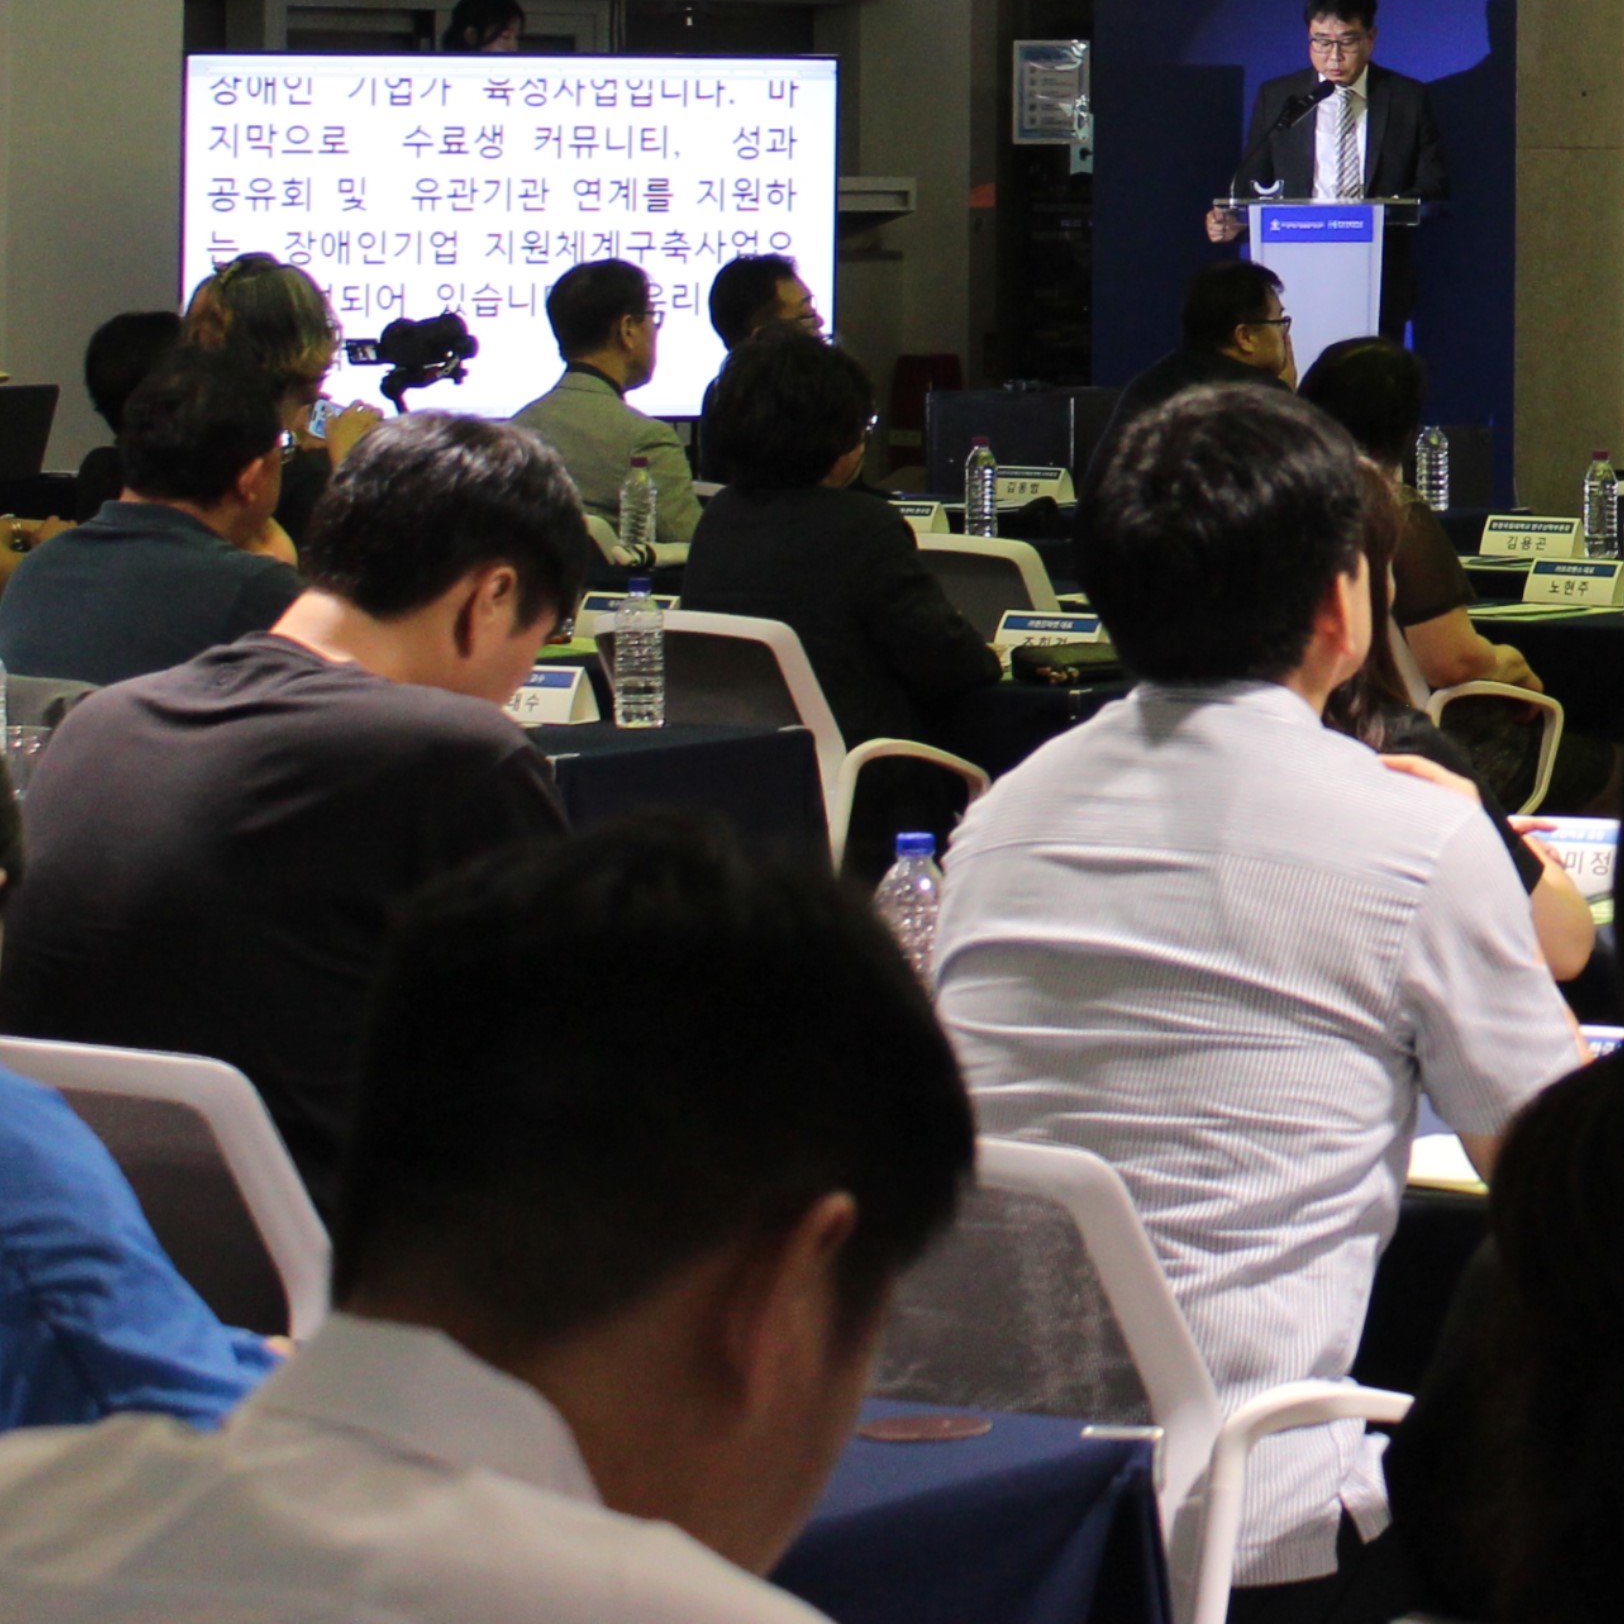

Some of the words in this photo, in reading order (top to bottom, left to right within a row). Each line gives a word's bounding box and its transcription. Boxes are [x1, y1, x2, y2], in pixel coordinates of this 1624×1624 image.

[209, 123, 350, 158] 지막으로
[402, 124, 504, 160] 수료생
[534, 124, 681, 160] 커뮤니티,
[732, 124, 798, 160] 성과
[207, 177, 312, 212] 공유회
[337, 176, 368, 212] 및
[410, 177, 550, 212] 유관기관
[573, 177, 674, 213] 연계를
[697, 177, 798, 212] 지원하
[284, 230, 458, 265] 장애인기업
[322, 282, 405, 318] 되어
[436, 282, 552, 318] 있습니
[1565, 850, 1612, 877] 미정
